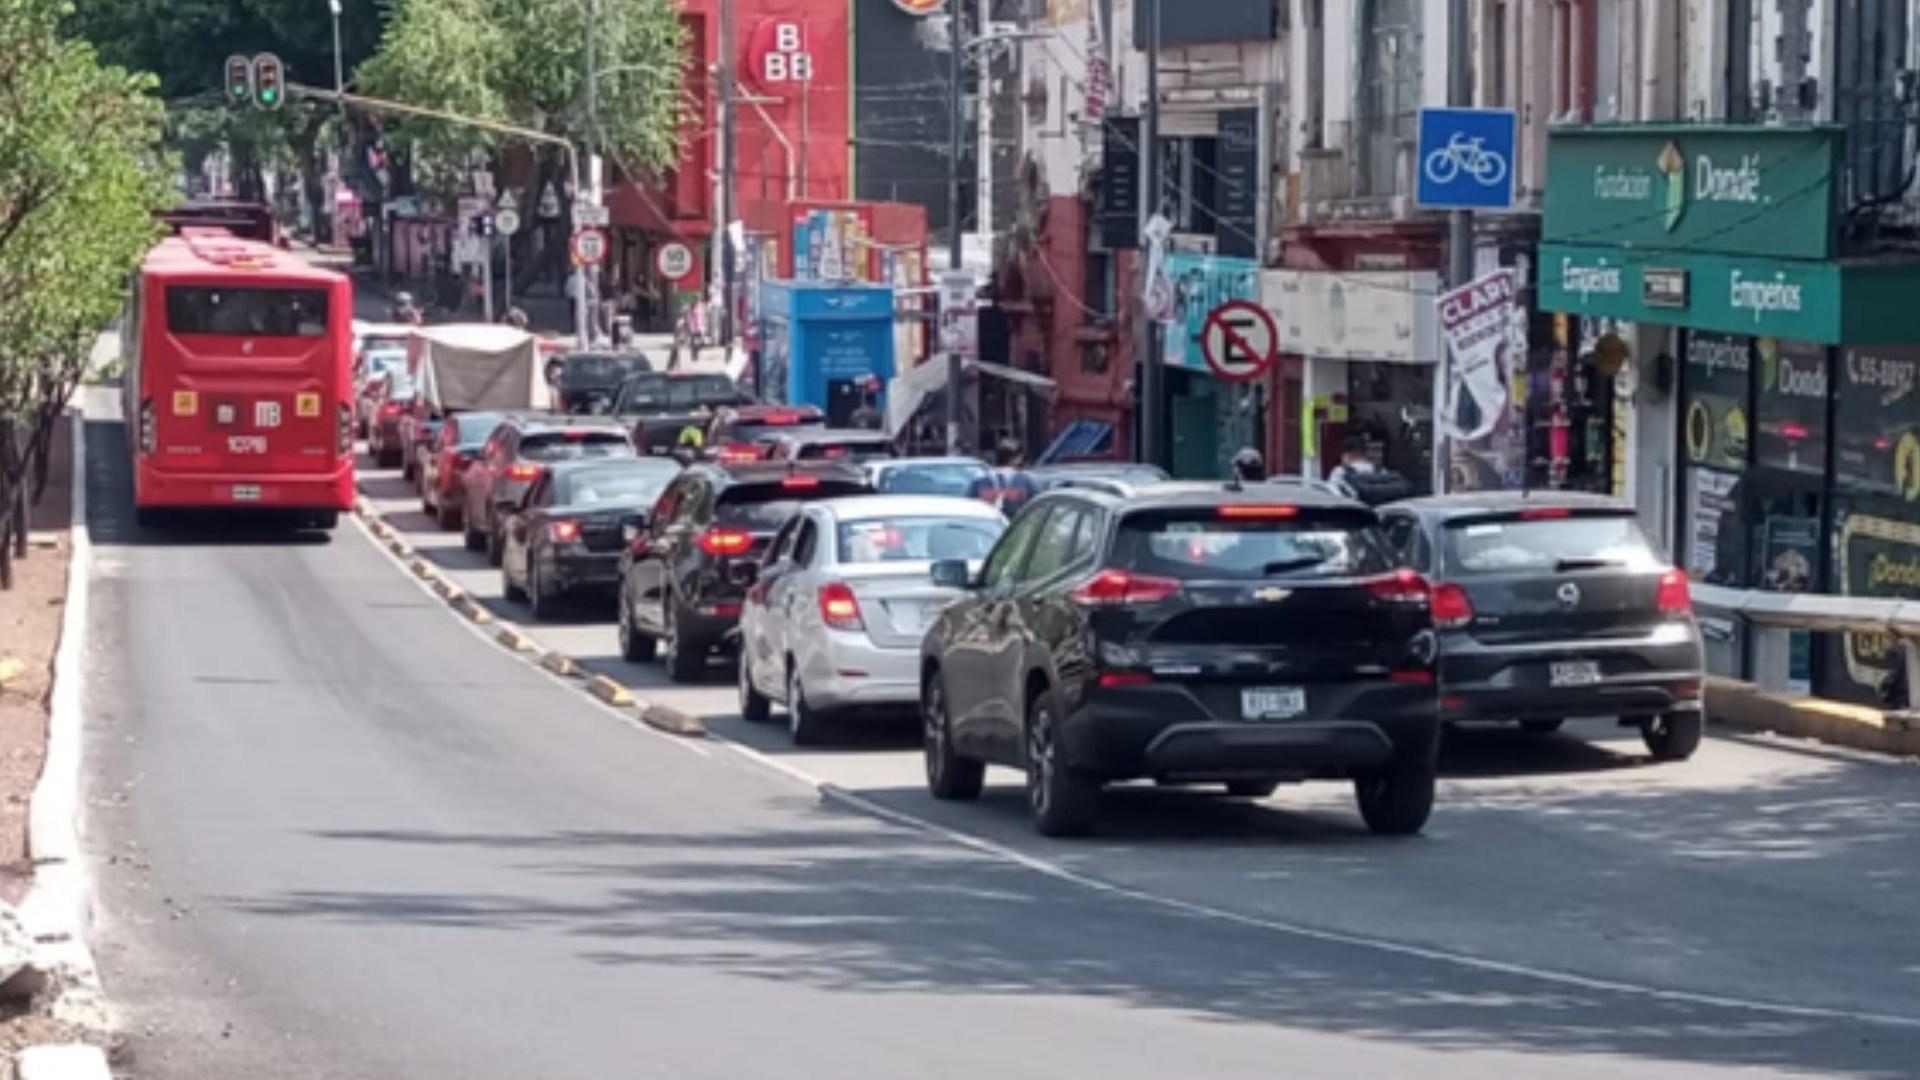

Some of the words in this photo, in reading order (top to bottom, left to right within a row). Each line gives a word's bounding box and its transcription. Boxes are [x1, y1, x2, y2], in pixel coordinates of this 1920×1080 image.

[776, 23, 801, 52] B
[1563, 257, 1621, 303] Empeños
[1731, 269, 1801, 323] Empeños
[1224, 319, 1256, 365] E
